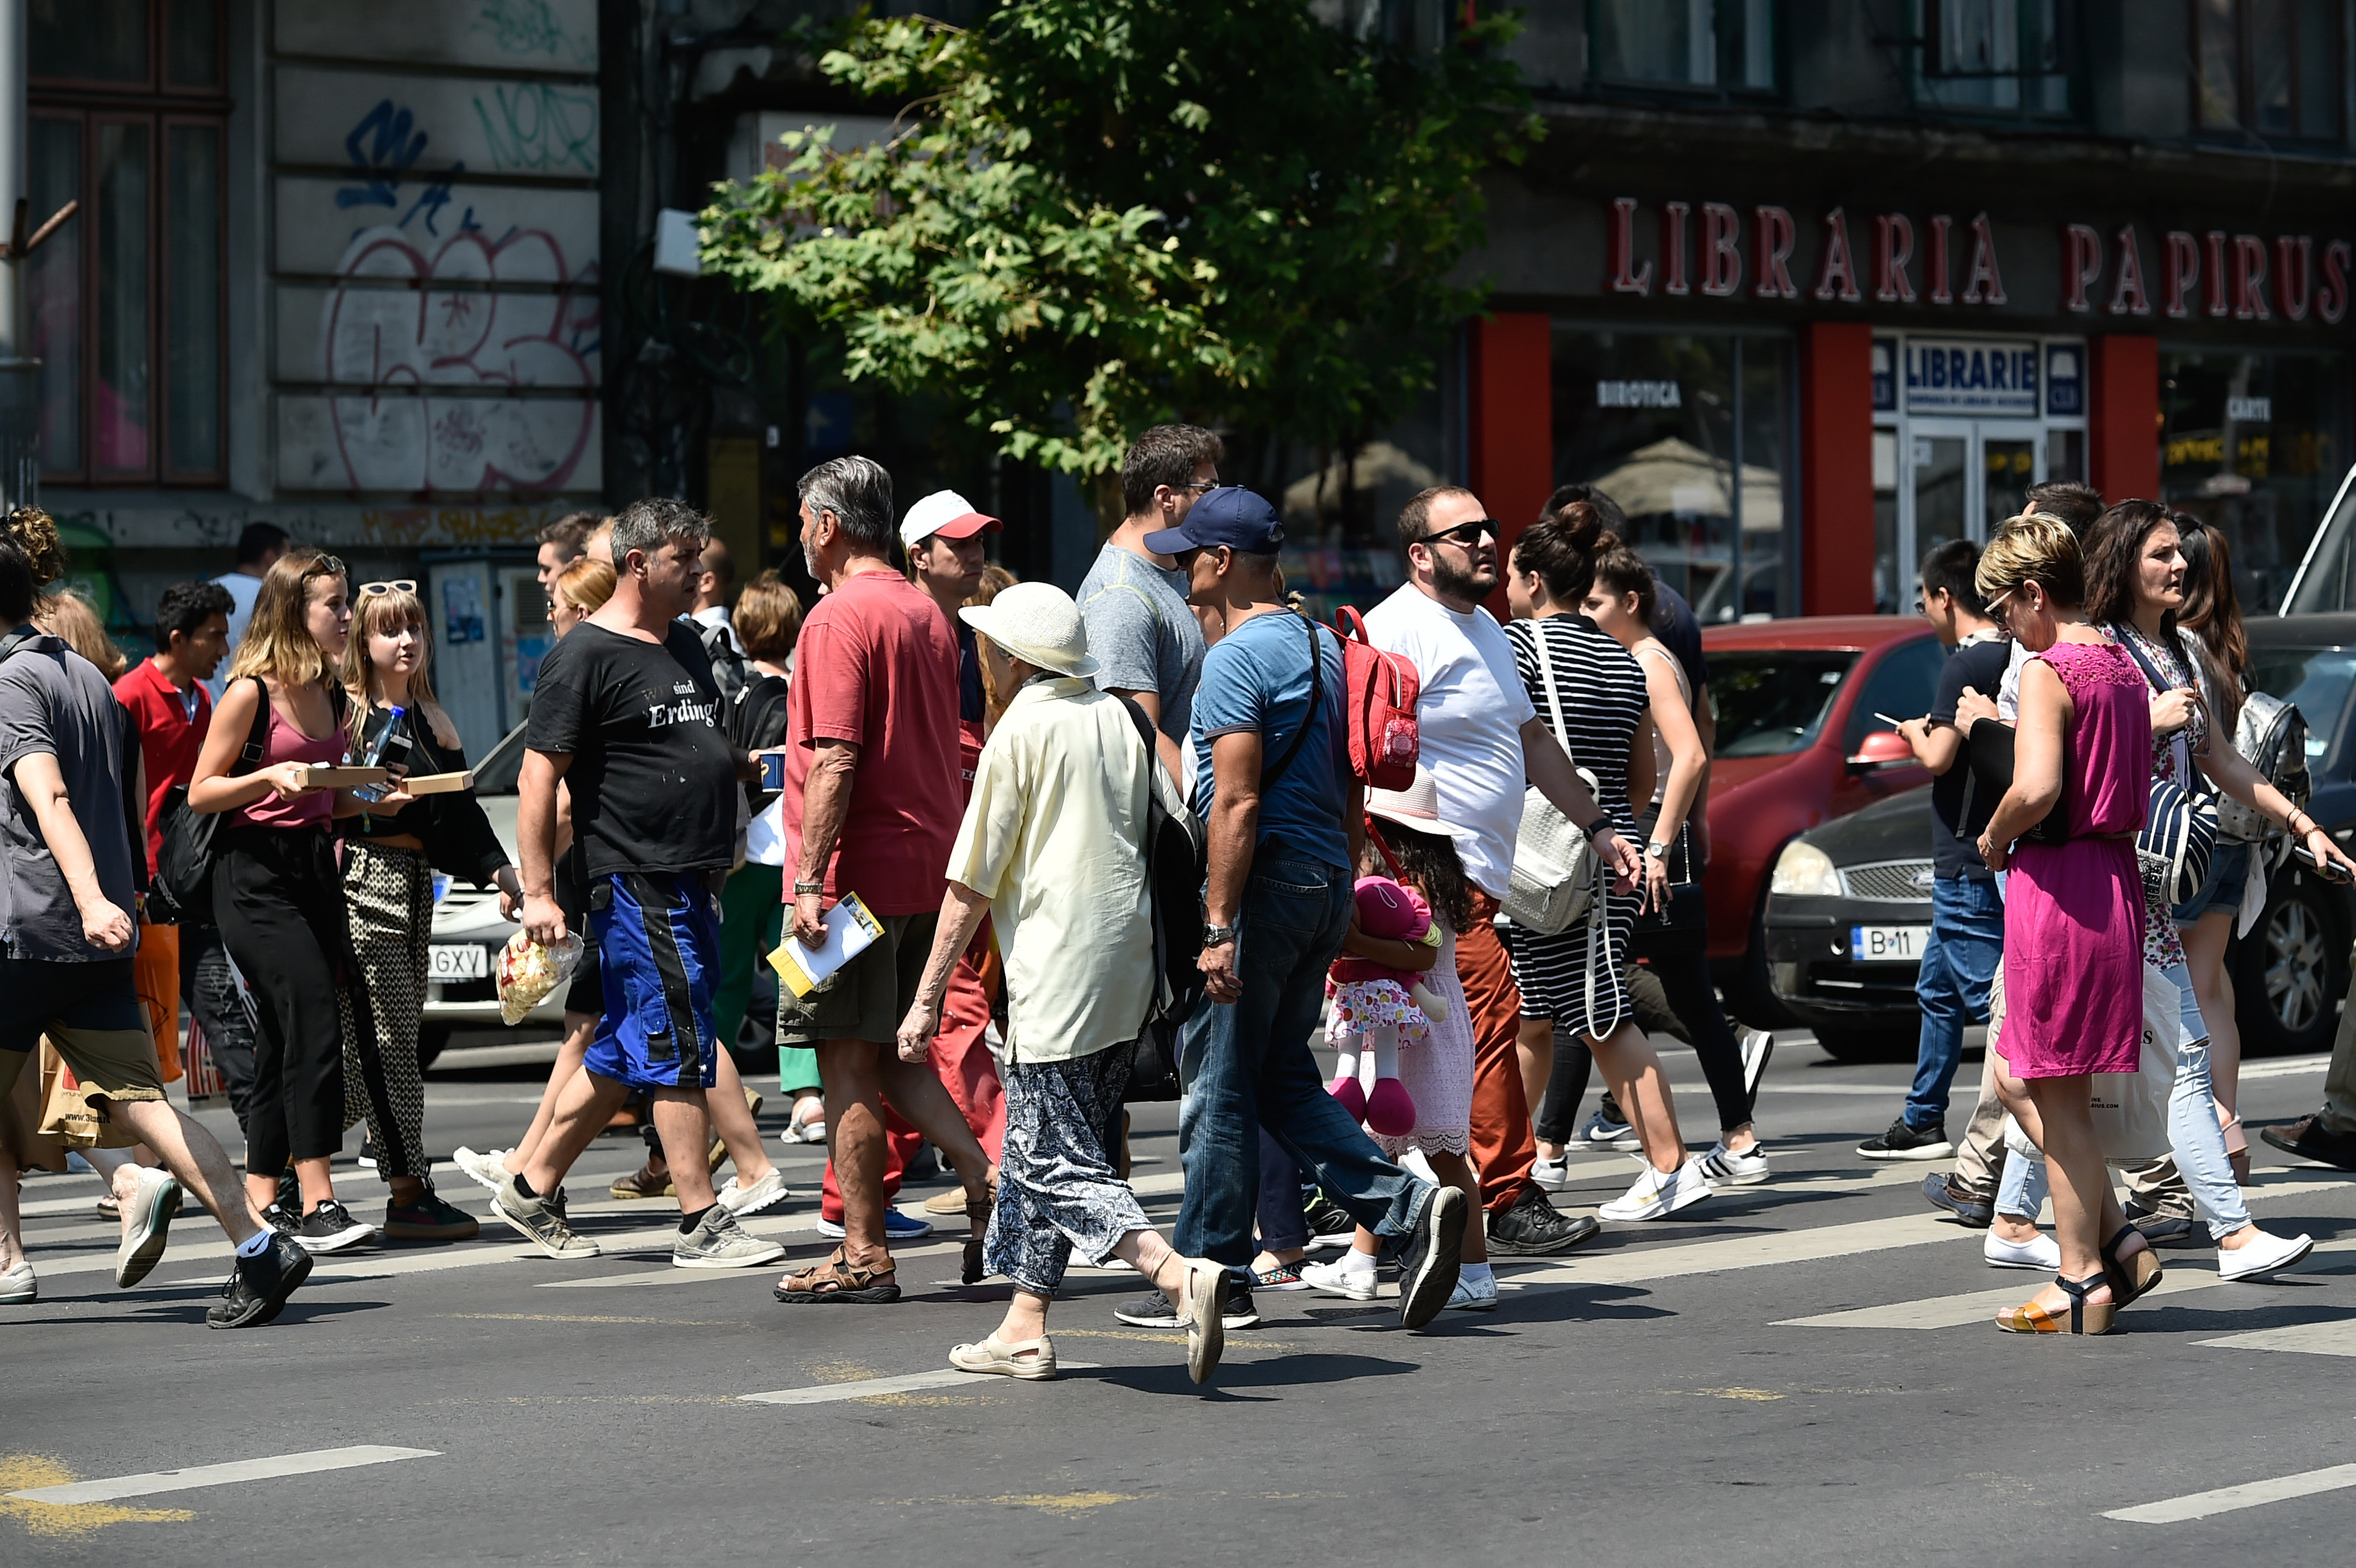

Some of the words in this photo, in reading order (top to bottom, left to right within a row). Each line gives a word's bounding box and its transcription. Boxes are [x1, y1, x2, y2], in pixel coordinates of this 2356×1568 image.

[1605, 197, 2008, 305] LIBRARIA
[2064, 223, 2352, 324] PAPIRUS
[1906, 345, 2035, 390] LIBRARIE
[673, 680, 695, 695] sind
[648, 697, 720, 729] Erding!
[1871, 931, 1886, 954] B
[1895, 931, 1910, 955] 11
